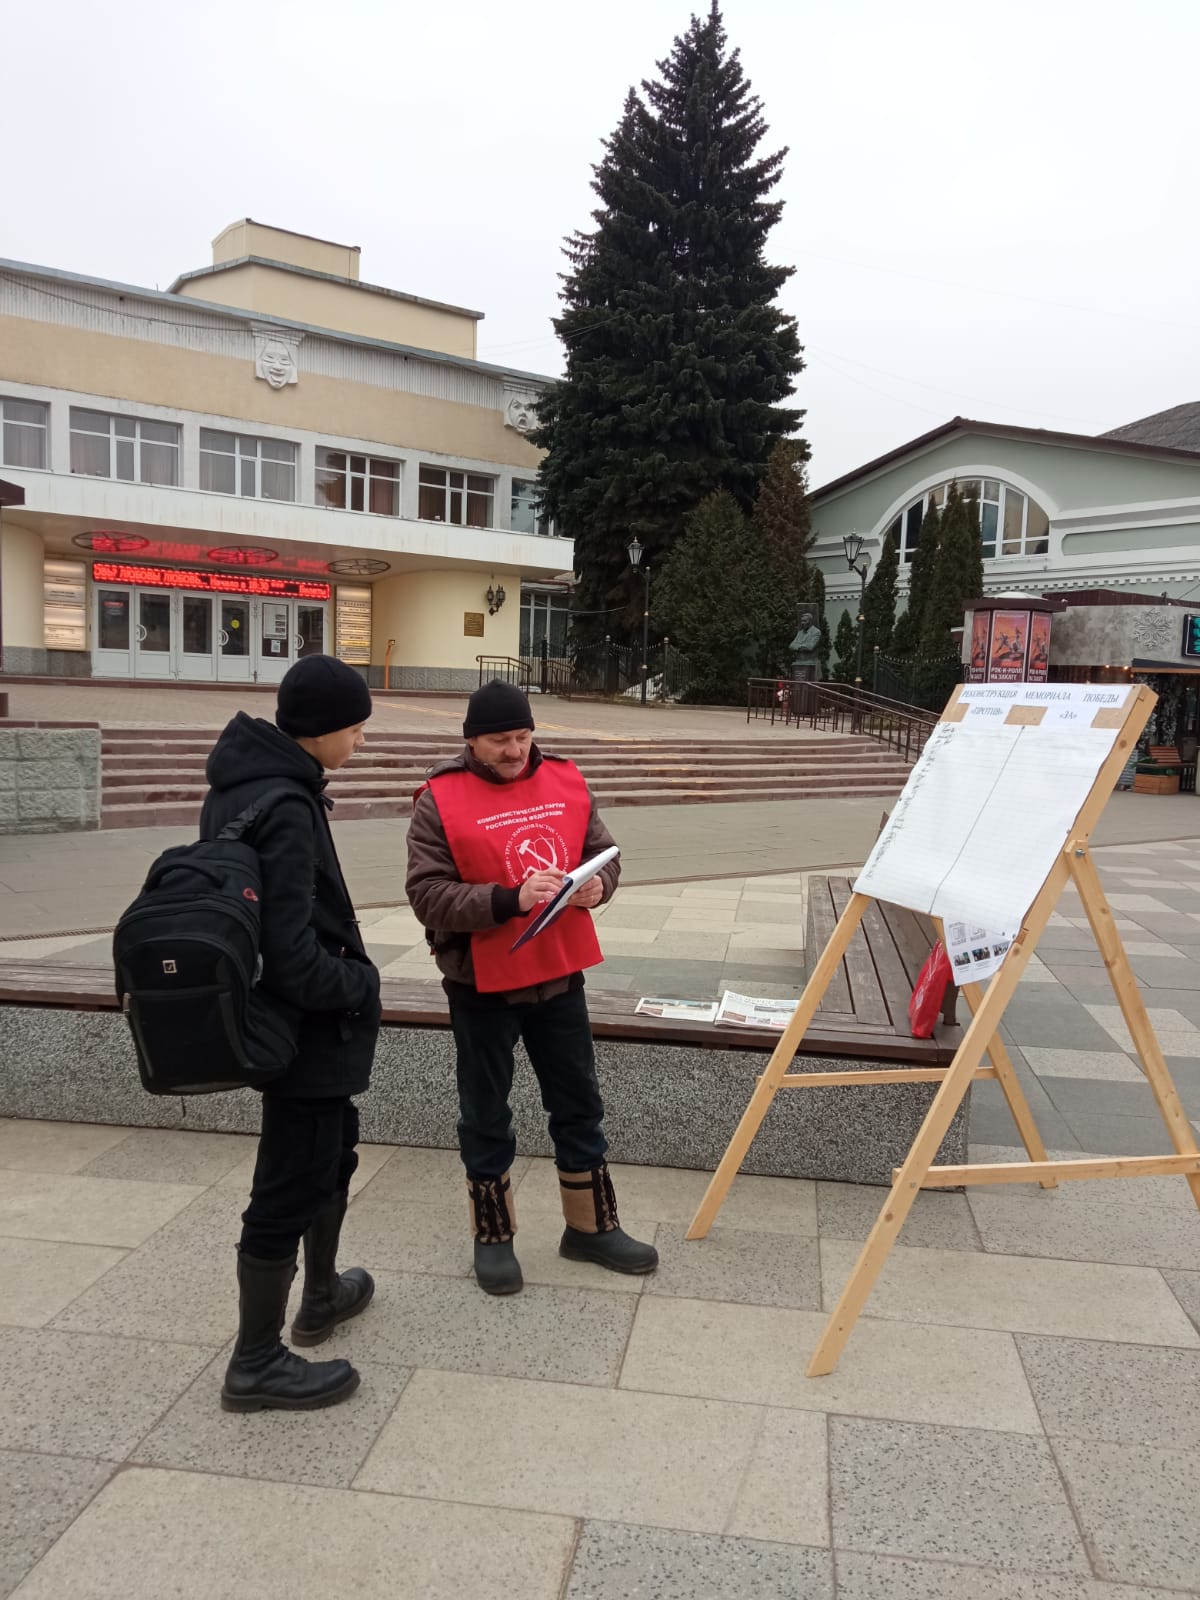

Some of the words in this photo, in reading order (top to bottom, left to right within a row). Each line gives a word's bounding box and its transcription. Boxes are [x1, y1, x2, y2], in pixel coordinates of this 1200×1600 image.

[962, 689, 1019, 699] РЕКОНСТРУКЦИЯ
[1025, 690, 1071, 700] МЕМОРИАЛА
[1082, 692, 1120, 703] ПОБЕДЫ
[476, 804, 545, 825] КОММУНИСТИЧЕСКАЯ
[544, 802, 566, 810] ПАРТИЯ
[485, 816, 528, 831] РОССИЙСКОЙ
[528, 810, 563, 821] ФЕДЕРАЦИИ
